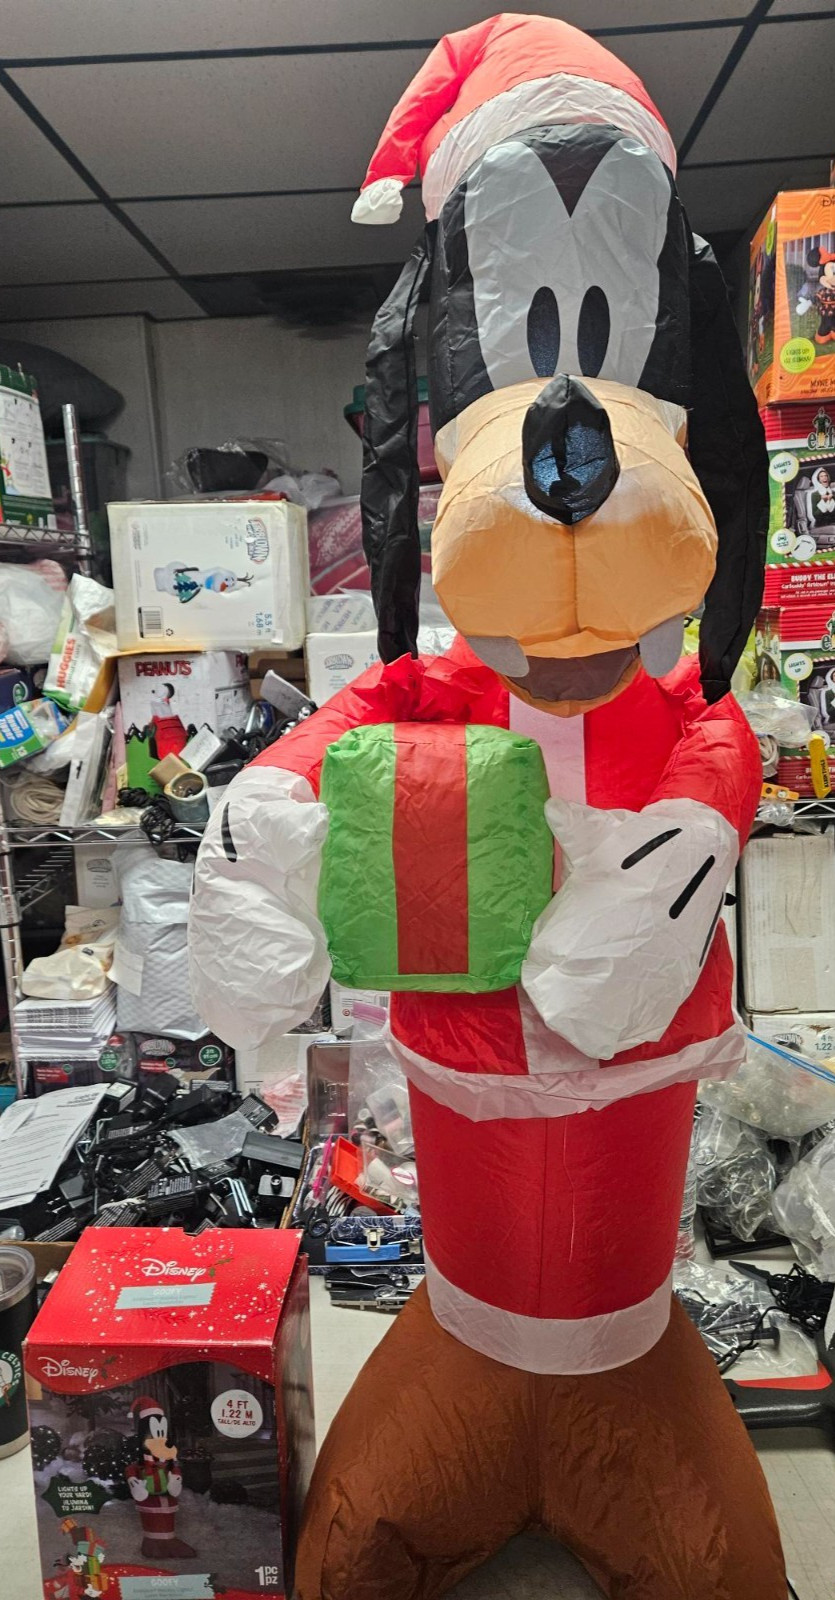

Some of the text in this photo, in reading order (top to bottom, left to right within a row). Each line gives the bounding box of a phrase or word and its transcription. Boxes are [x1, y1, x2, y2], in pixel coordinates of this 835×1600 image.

[773, 460, 791, 469] LIGHTS
[256, 612, 264, 628] 1.68
[264, 613, 272, 626] 5.5
[56, 638, 76, 688] HUGGIES
[135, 660, 192, 677] PEANUTS
[788, 660, 806, 668] LIGHTS
[814, 1042, 832, 1051] 1.22
[141, 1257, 207, 1282] Disney
[1, 1351, 21, 1386] CELTICS
[37, 1356, 99, 1384] Disney
[226, 1399, 249, 1409] 4 FT
[221, 1408, 253, 1419] 1.22 M
[150, 1577, 180, 1587] GOOFY
